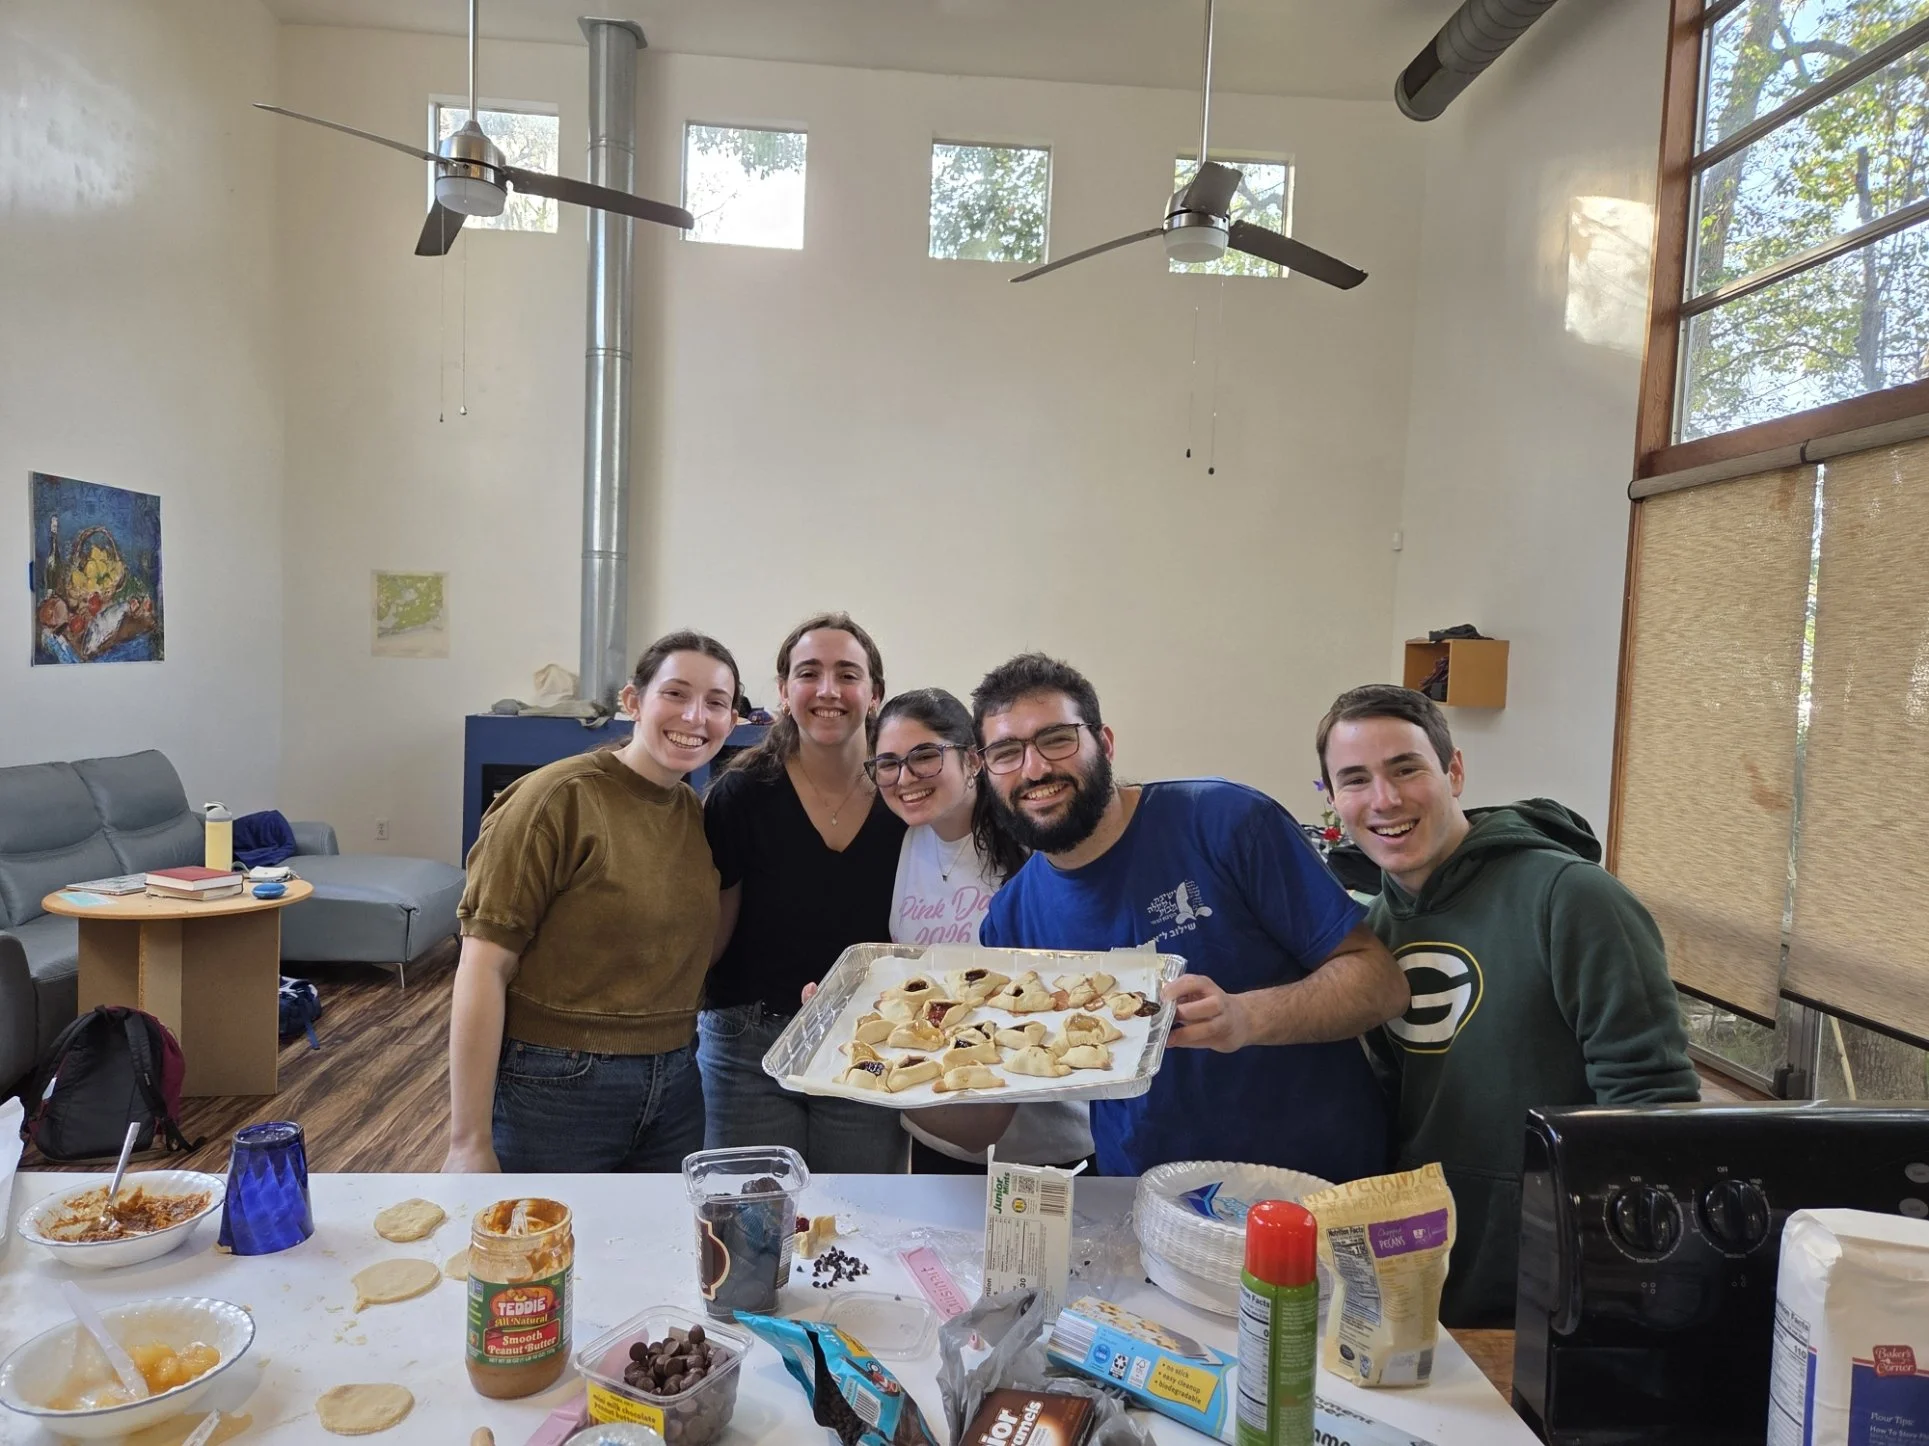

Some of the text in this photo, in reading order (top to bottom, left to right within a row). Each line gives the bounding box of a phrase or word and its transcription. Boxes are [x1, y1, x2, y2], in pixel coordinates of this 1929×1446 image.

[899, 886, 991, 926] Pink Da
[1387, 952, 1471, 1043] G
[993, 1177, 1004, 1214] Junior
[498, 1297, 546, 1316] TEDDIE
[495, 1314, 548, 1327] All Natural
[488, 1336, 556, 1355] Peanut Butter
[502, 1330, 543, 1346] Smooth
[1875, 1347, 1912, 1359] Baker's
[1175, 1368, 1189, 1378] stick
[1877, 1363, 1914, 1375] Corner
[1163, 1373, 1201, 1394] easy cleanup
[1159, 1381, 1202, 1405] biodegradable
[622, 1407, 656, 1423] chocolate
[1871, 1411, 1893, 1422] Flour
